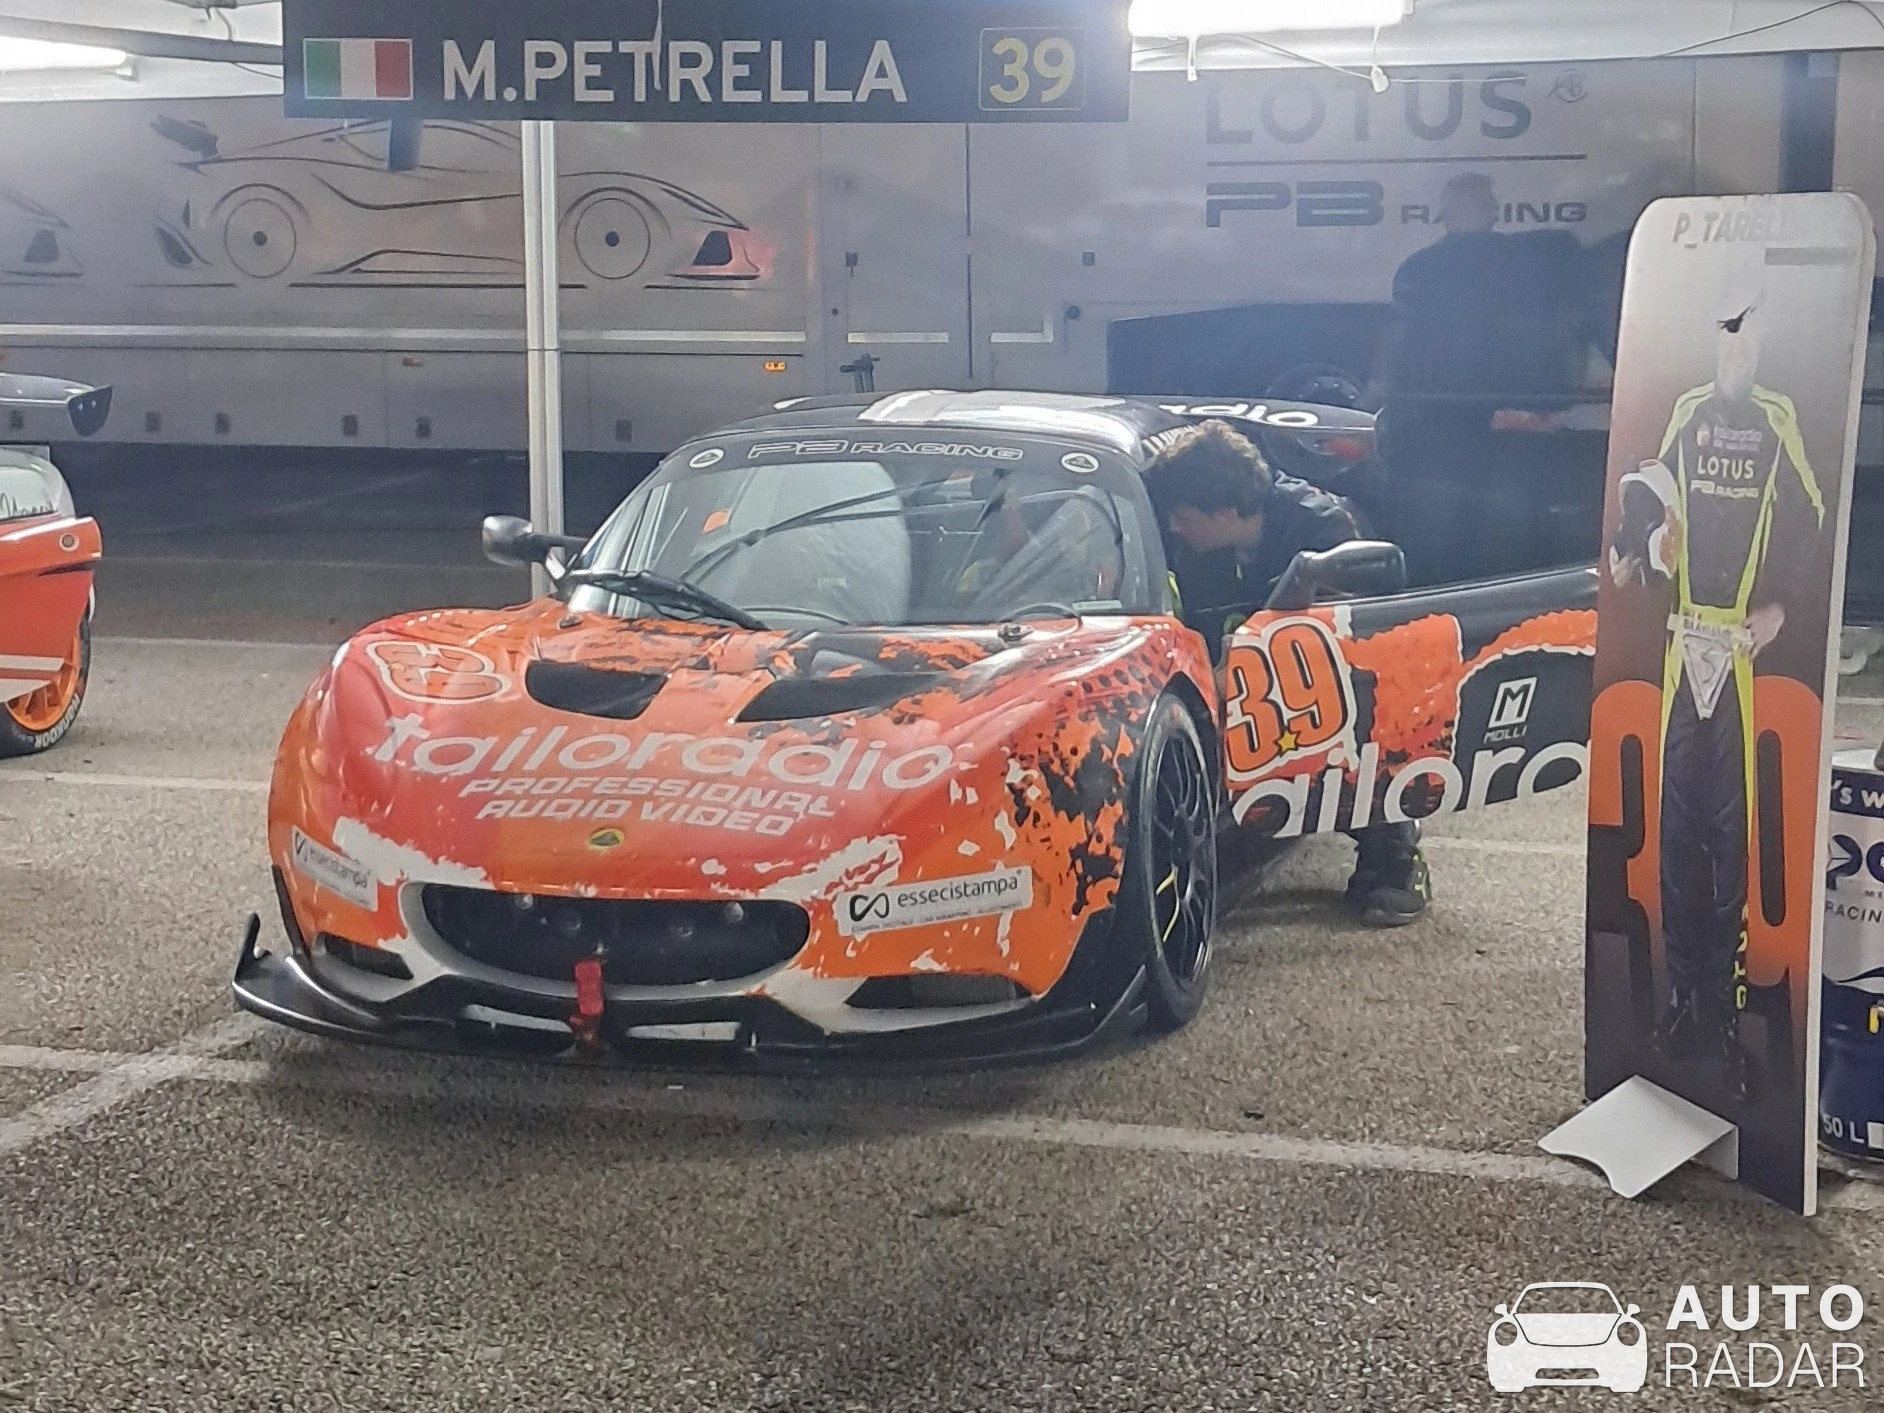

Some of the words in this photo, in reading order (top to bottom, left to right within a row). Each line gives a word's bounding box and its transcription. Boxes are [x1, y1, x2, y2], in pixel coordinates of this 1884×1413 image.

[442, 38, 907, 103] M.PETRELLA
[988, 37, 1077, 104] 39
[1206, 72, 1532, 144] LOTUS
[1206, 181, 1385, 228] PB
[1401, 202, 1587, 224] RING
[747, 440, 848, 459] PB
[850, 442, 1024, 460] RACING
[1696, 455, 1755, 480] LOTUS
[1226, 620, 1349, 773] 39
[373, 712, 954, 792] tailoradio
[458, 774, 835, 817] PROFESSIONAL
[475, 797, 630, 822] AUDIO
[638, 801, 795, 838] VIDEO
[897, 874, 1018, 908] essecistampa
[1849, 1120, 1866, 1145] L
